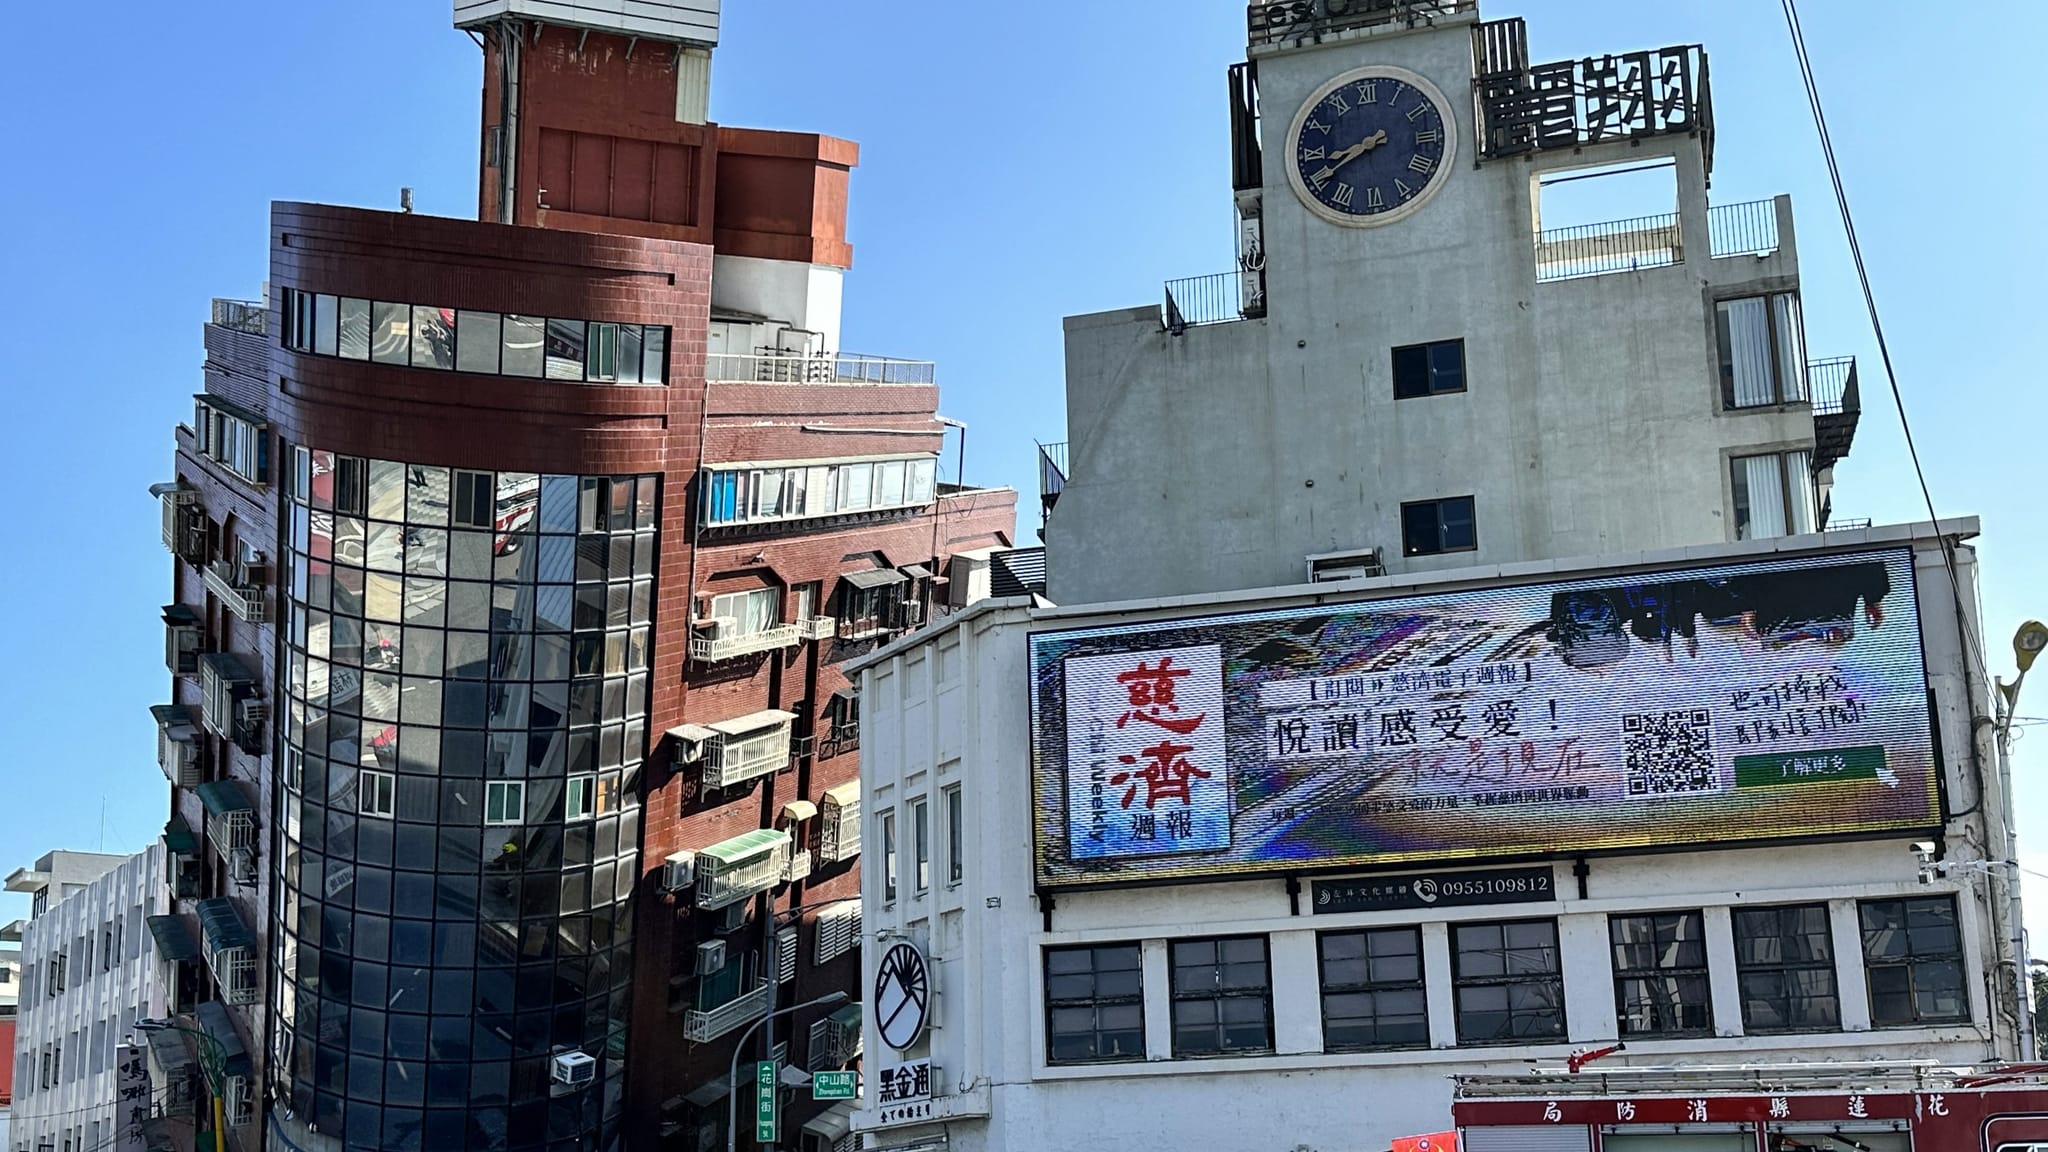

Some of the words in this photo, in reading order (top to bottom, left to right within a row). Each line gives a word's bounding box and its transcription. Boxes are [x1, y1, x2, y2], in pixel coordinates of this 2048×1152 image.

[1357, 83, 1377, 105] XII
[1328, 94, 1351, 117] XI
[1405, 102, 1429, 122] II
[1309, 119, 1331, 135] X
[1415, 129, 1437, 145] III
[1304, 145, 1325, 162] IX
[1331, 182, 1354, 207] VII
[1367, 187, 1384, 207] VI
[1394, 178, 1411, 197] V
[1110, 656, 1212, 810] 慈濟
[1088, 760, 1105, 842] Weekly
[1131, 810, 1192, 841] 週報
[1442, 876, 1549, 896] 0955109812
[819, 1073, 850, 1086] 中山路
[879, 1063, 930, 1103] 黑金通
